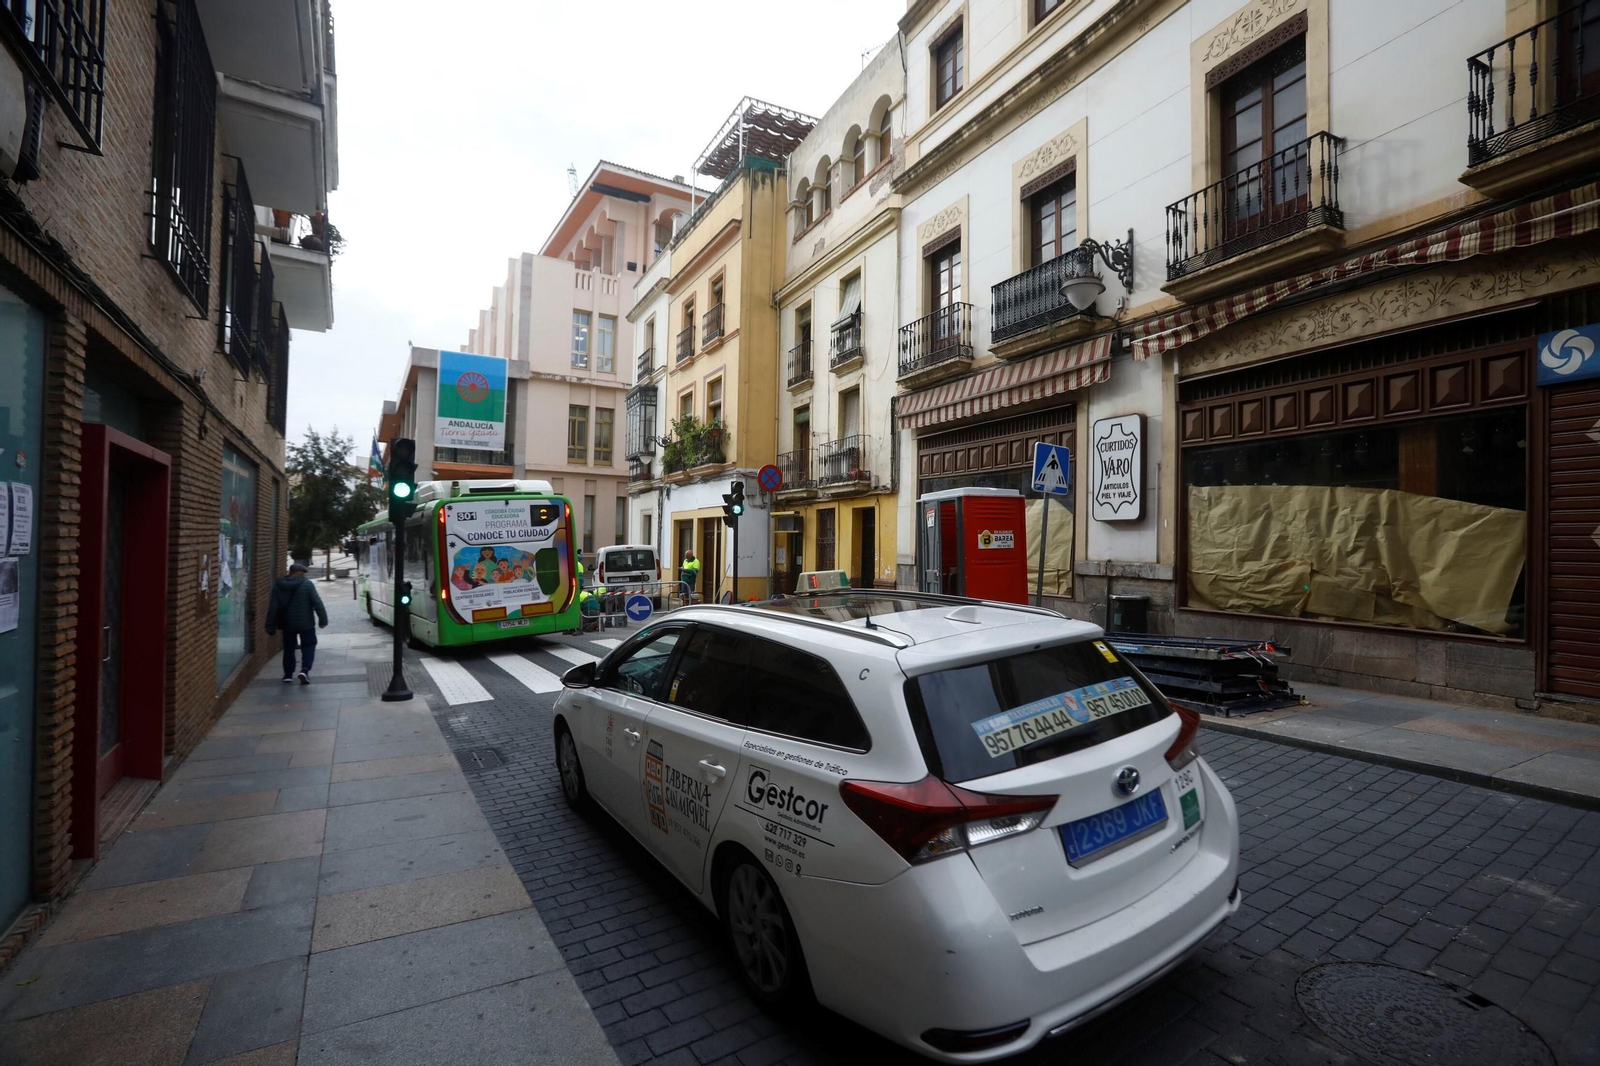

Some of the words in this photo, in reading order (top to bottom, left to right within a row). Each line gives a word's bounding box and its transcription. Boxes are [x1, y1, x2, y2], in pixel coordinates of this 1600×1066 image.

[448, 420, 494, 430] ANDALUCÍA
[1100, 438, 1134, 453] CURTIDOS
[1103, 456, 1130, 480] VARO
[1103, 482, 1129, 490] ARTICULOS
[1101, 492, 1112, 500] PIEL
[457, 511, 477, 521] 301
[485, 519, 528, 529] PROGRAMA
[467, 530, 503, 541] CONOCE
[505, 530, 516, 538] TU
[518, 528, 550, 538] CIUDAD
[454, 593, 473, 601] CENTROS
[859, 668, 870, 681] C
[1086, 697, 1111, 717] 957
[985, 728, 1015, 755] 957
[1012, 721, 1037, 743] 76
[1034, 715, 1056, 735] 44
[1051, 709, 1073, 729] 44
[776, 750, 785, 760] en
[783, 753, 814, 767] gestiones
[814, 760, 824, 769] de
[665, 764, 711, 808] TABERNA
[1174, 769, 1194, 791] 129C
[665, 786, 678, 810] SAN
[748, 770, 829, 824] Gestcor
[1078, 808, 1128, 851] 2369
[1132, 791, 1161, 827] JKF
[778, 827, 792, 841] 717
[792, 833, 807, 847] 329
